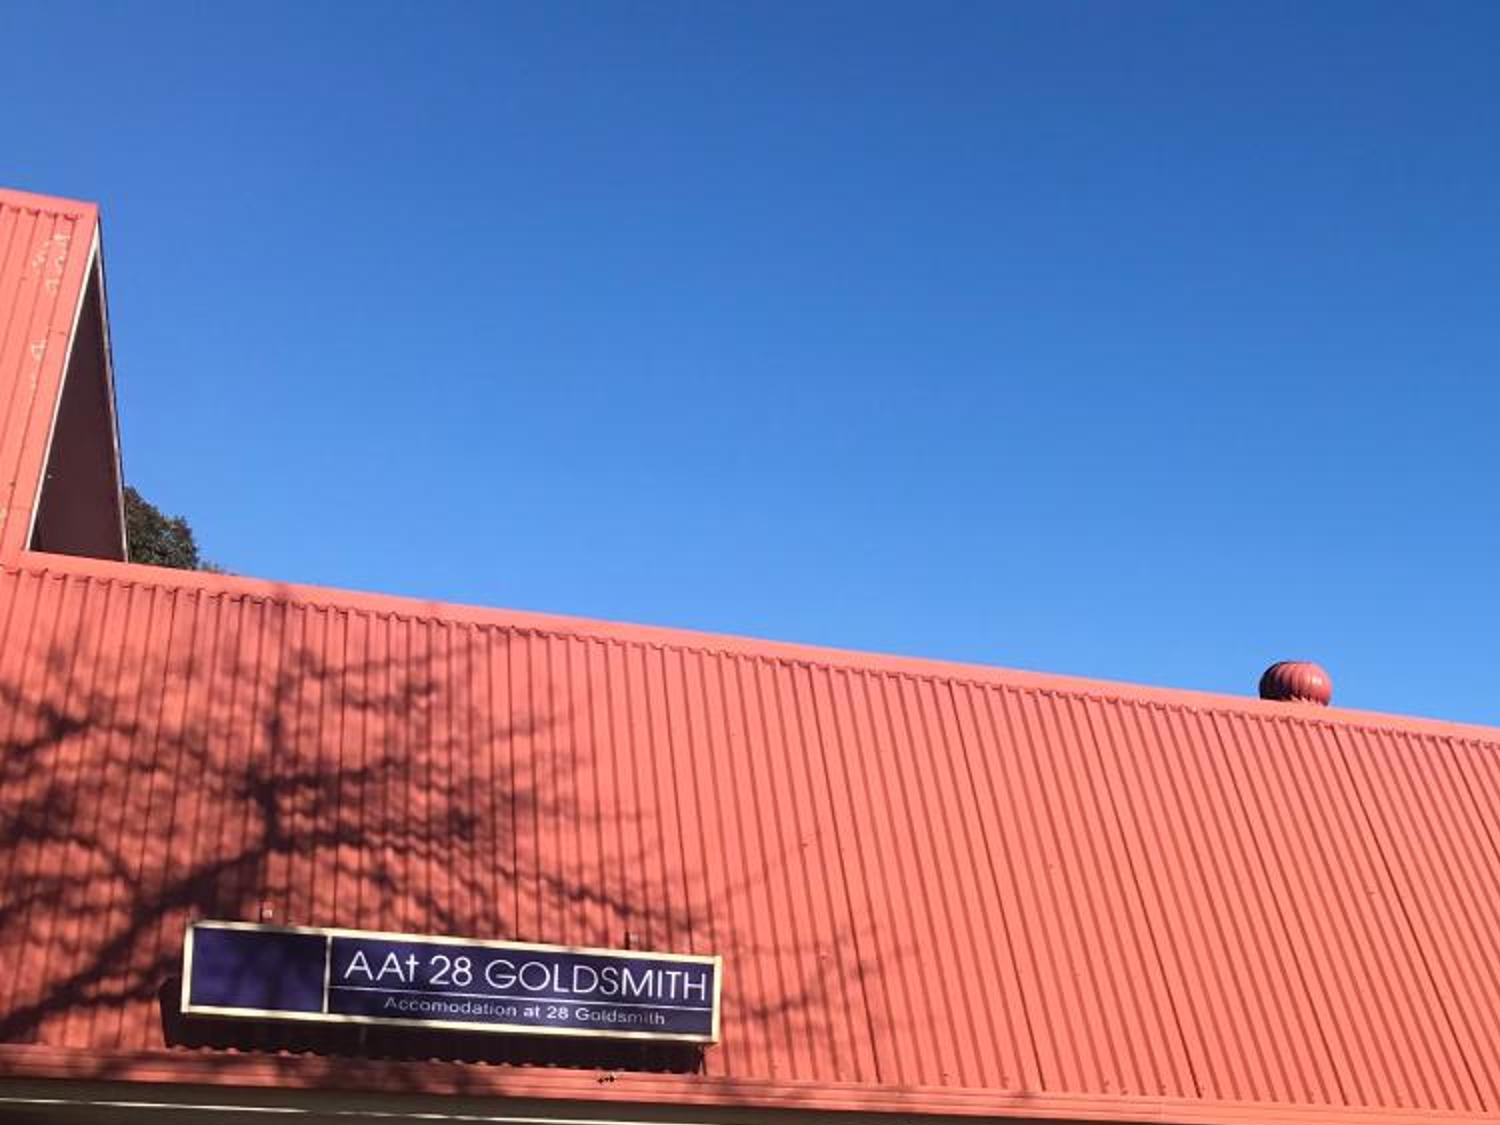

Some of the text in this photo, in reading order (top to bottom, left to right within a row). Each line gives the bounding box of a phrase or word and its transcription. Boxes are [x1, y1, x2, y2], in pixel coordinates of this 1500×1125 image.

[343, 950, 706, 1001] AAt 28 GOLDSMITH
[385, 996, 665, 1026] Accomodation at 28 Goldsmith
